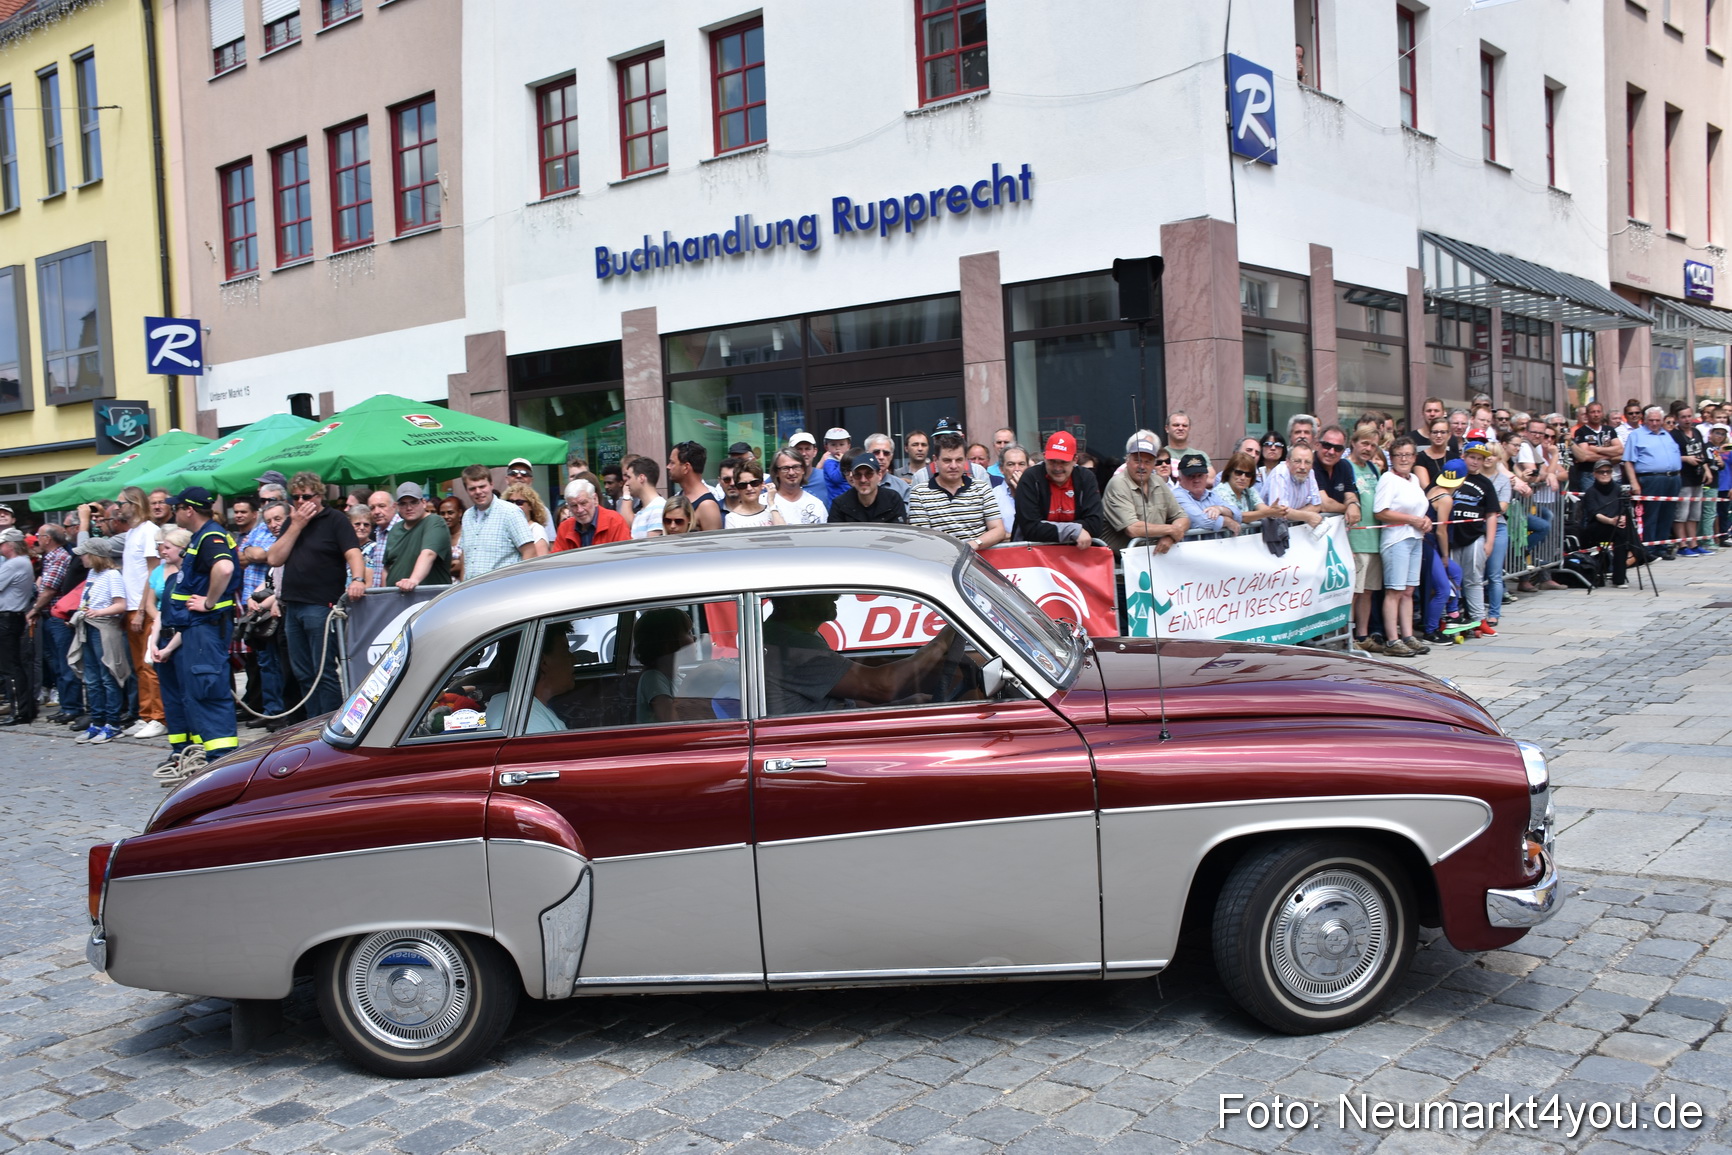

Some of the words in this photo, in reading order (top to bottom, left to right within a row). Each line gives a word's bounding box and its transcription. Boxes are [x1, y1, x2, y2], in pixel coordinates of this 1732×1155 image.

[595, 213, 819, 280] Buchhandlung
[832, 163, 1034, 237] Rupprecht
[1196, 577, 1236, 602] UNS
[1245, 588, 1313, 618] BESSER
